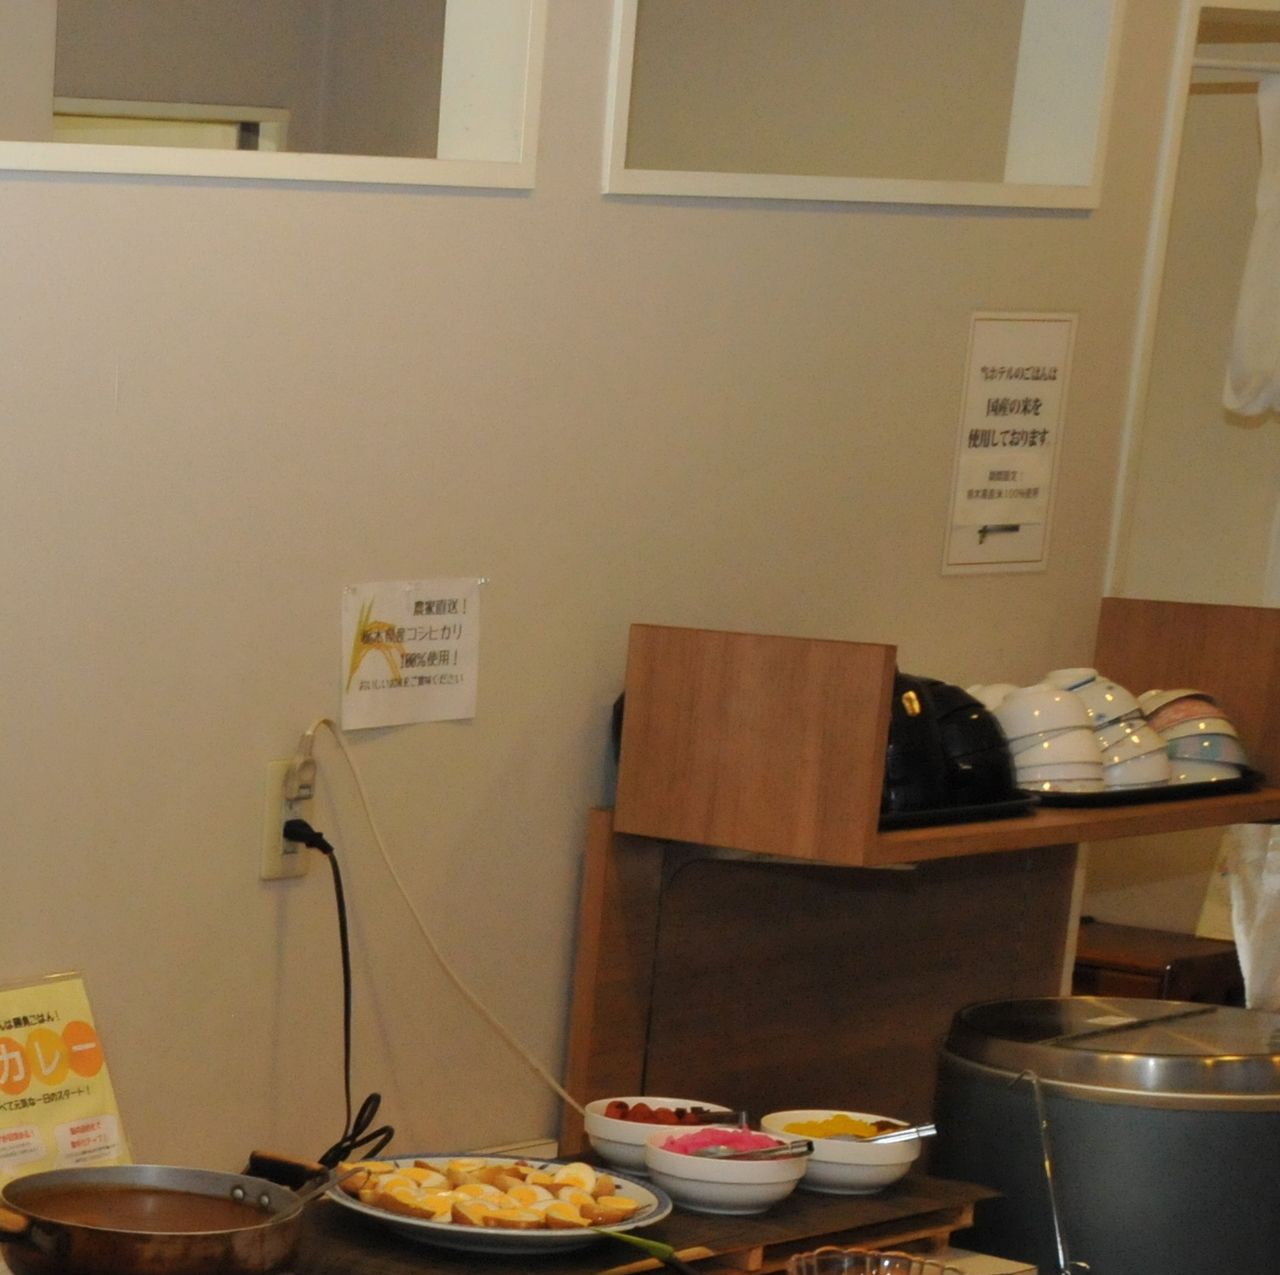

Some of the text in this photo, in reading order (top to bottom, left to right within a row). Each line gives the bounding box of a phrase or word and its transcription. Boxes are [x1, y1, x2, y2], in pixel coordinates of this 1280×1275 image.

[968, 427, 1049, 449] 使用しております
